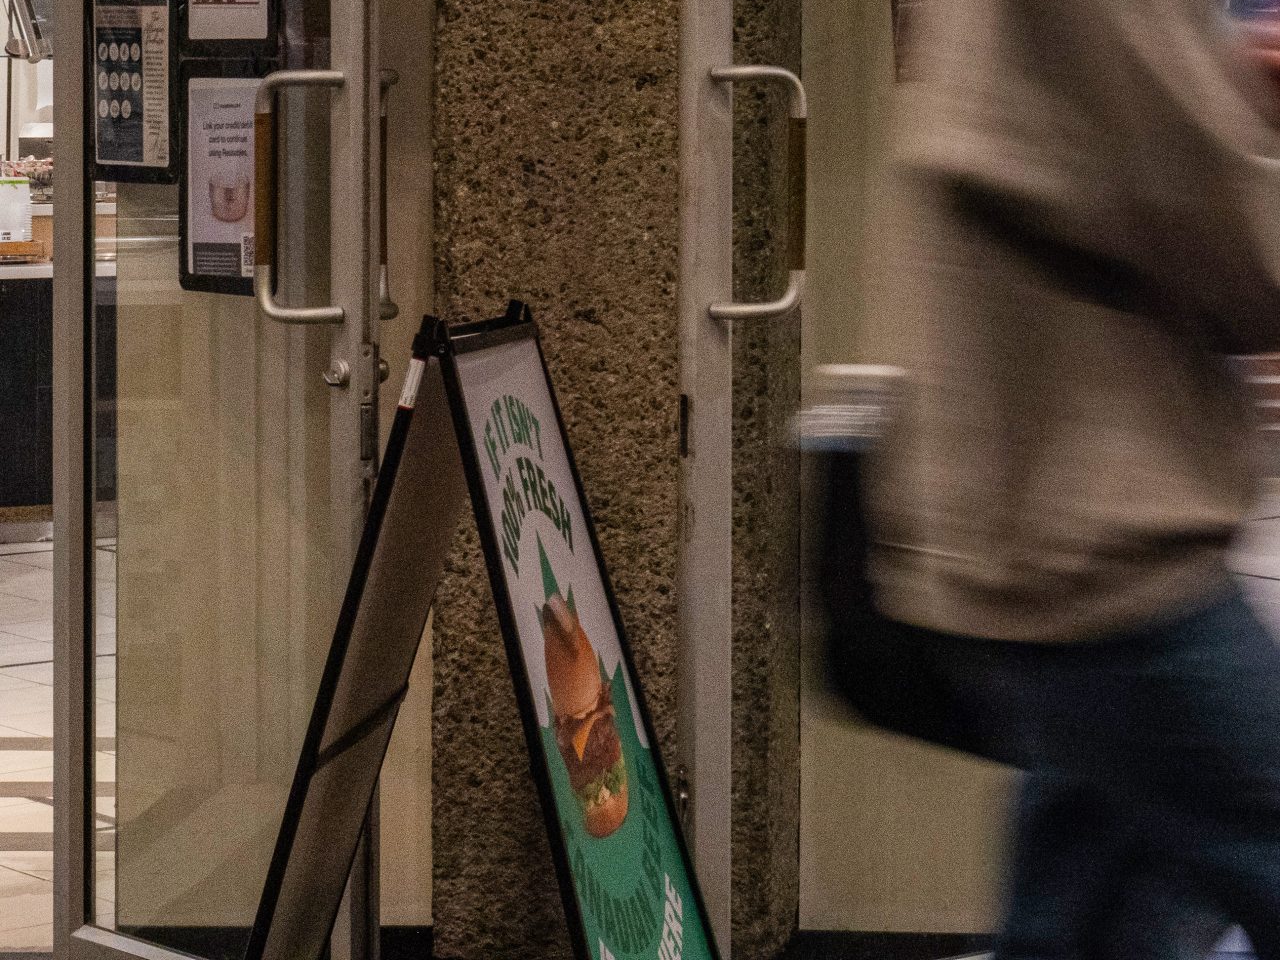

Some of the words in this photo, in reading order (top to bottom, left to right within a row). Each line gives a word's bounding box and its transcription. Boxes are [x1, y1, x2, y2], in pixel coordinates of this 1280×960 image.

[484, 418, 502, 484] IF
[491, 398, 510, 456] IT
[501, 466, 526, 580] 100%
[516, 456, 575, 557] FRESH
